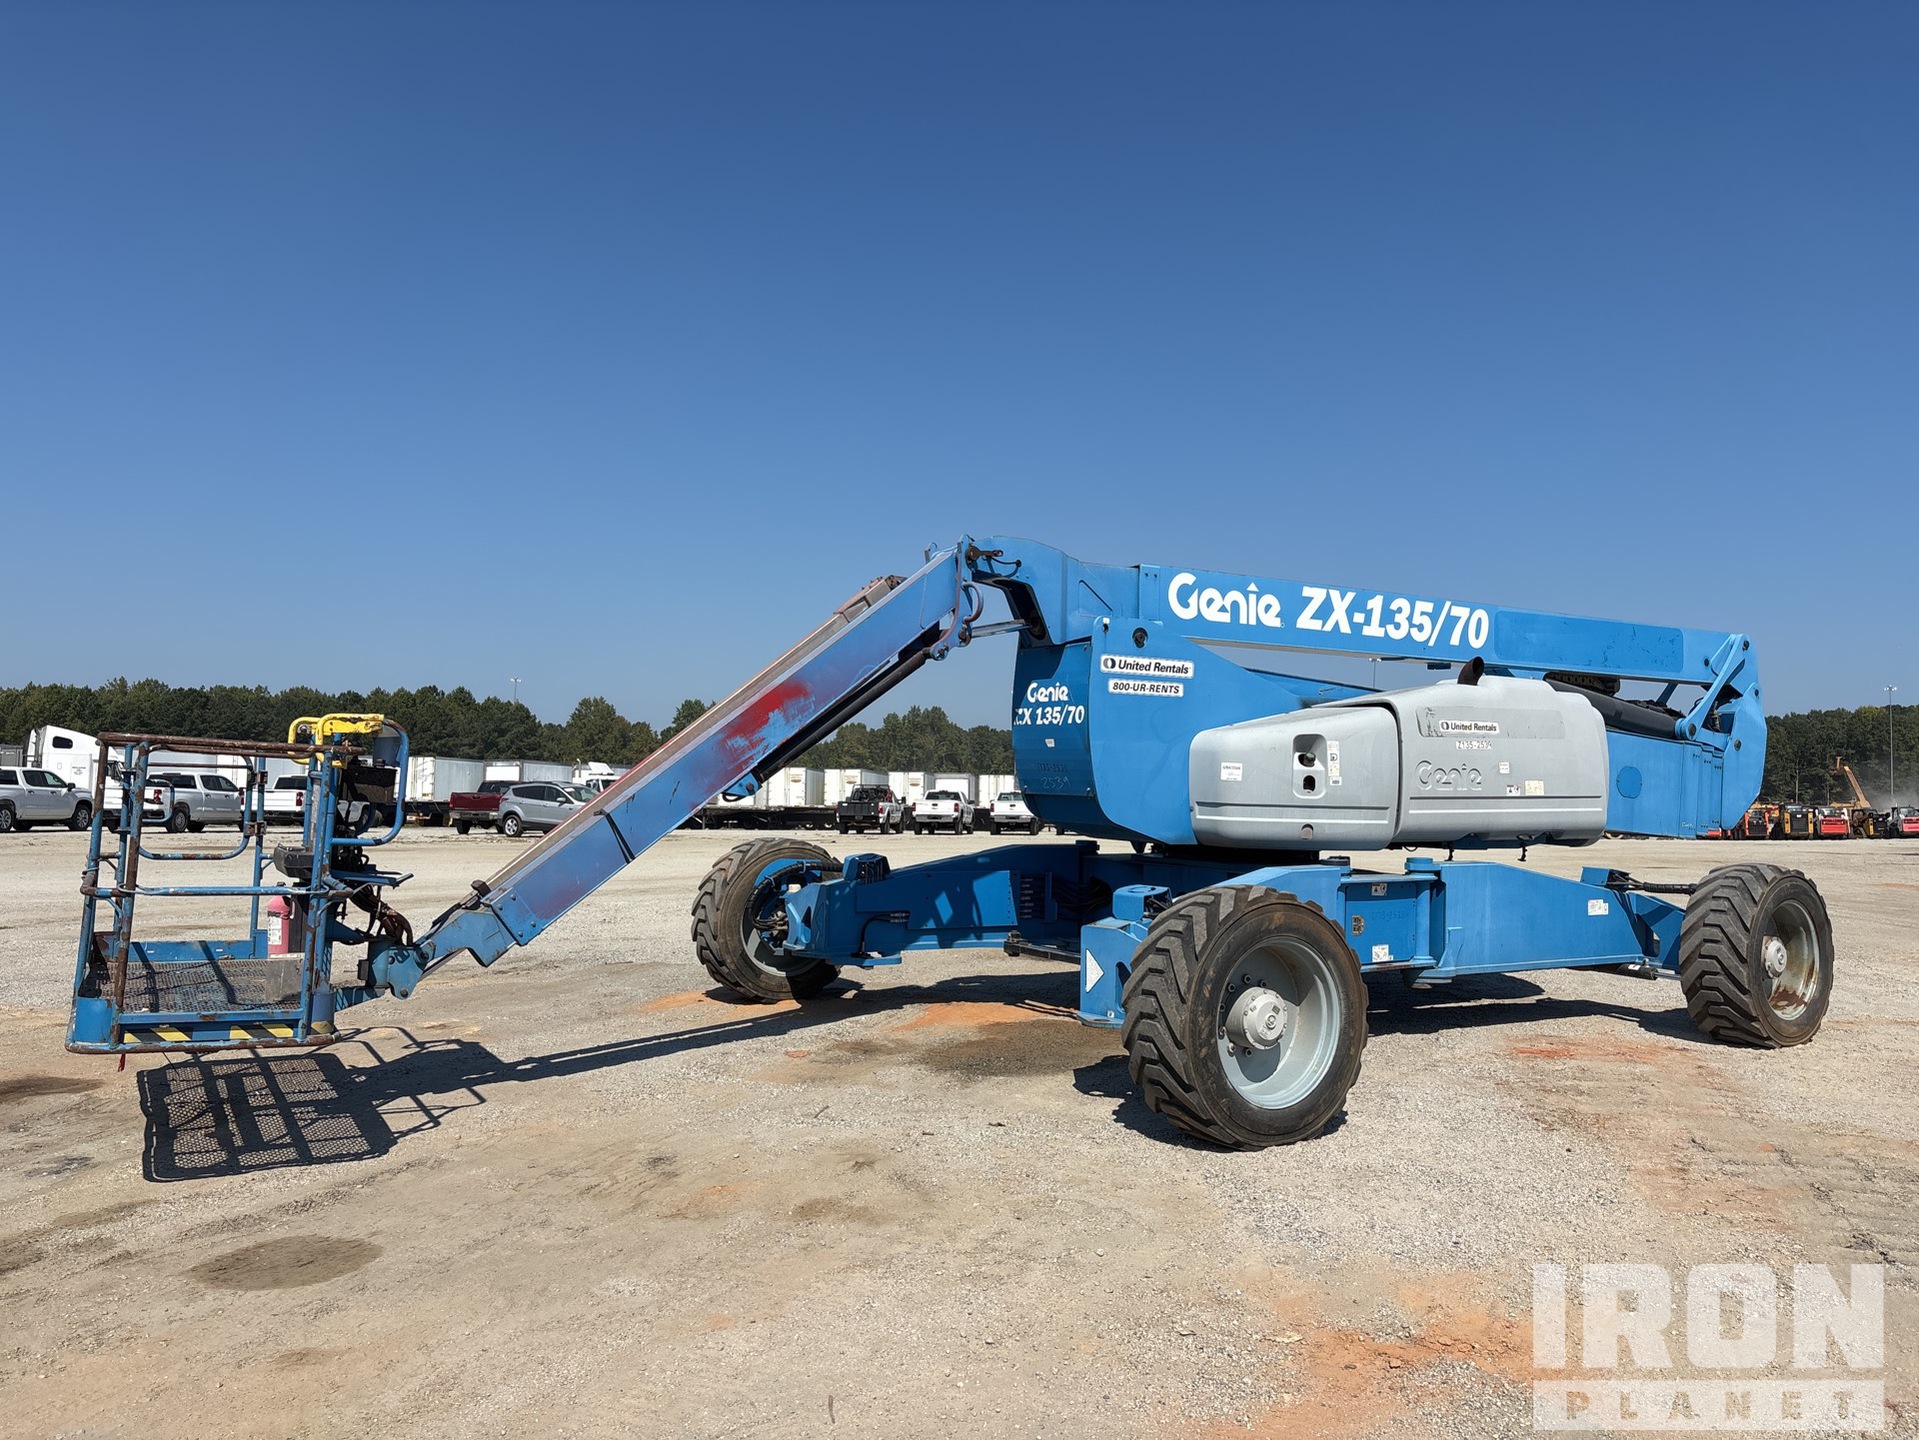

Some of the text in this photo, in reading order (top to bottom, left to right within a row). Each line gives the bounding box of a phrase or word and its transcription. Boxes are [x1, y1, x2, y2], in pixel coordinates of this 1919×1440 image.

[1168, 572, 1490, 649] Genie ZX-135/70
[1118, 659, 1189, 674] United Rentals
[1027, 682, 1068, 703] Genie
[1112, 682, 1180, 694] 800-UR-RENTS
[1036, 704, 1085, 726] 135/70
[1451, 723, 1497, 732] United Rentals
[1040, 776, 1072, 790] 2539
